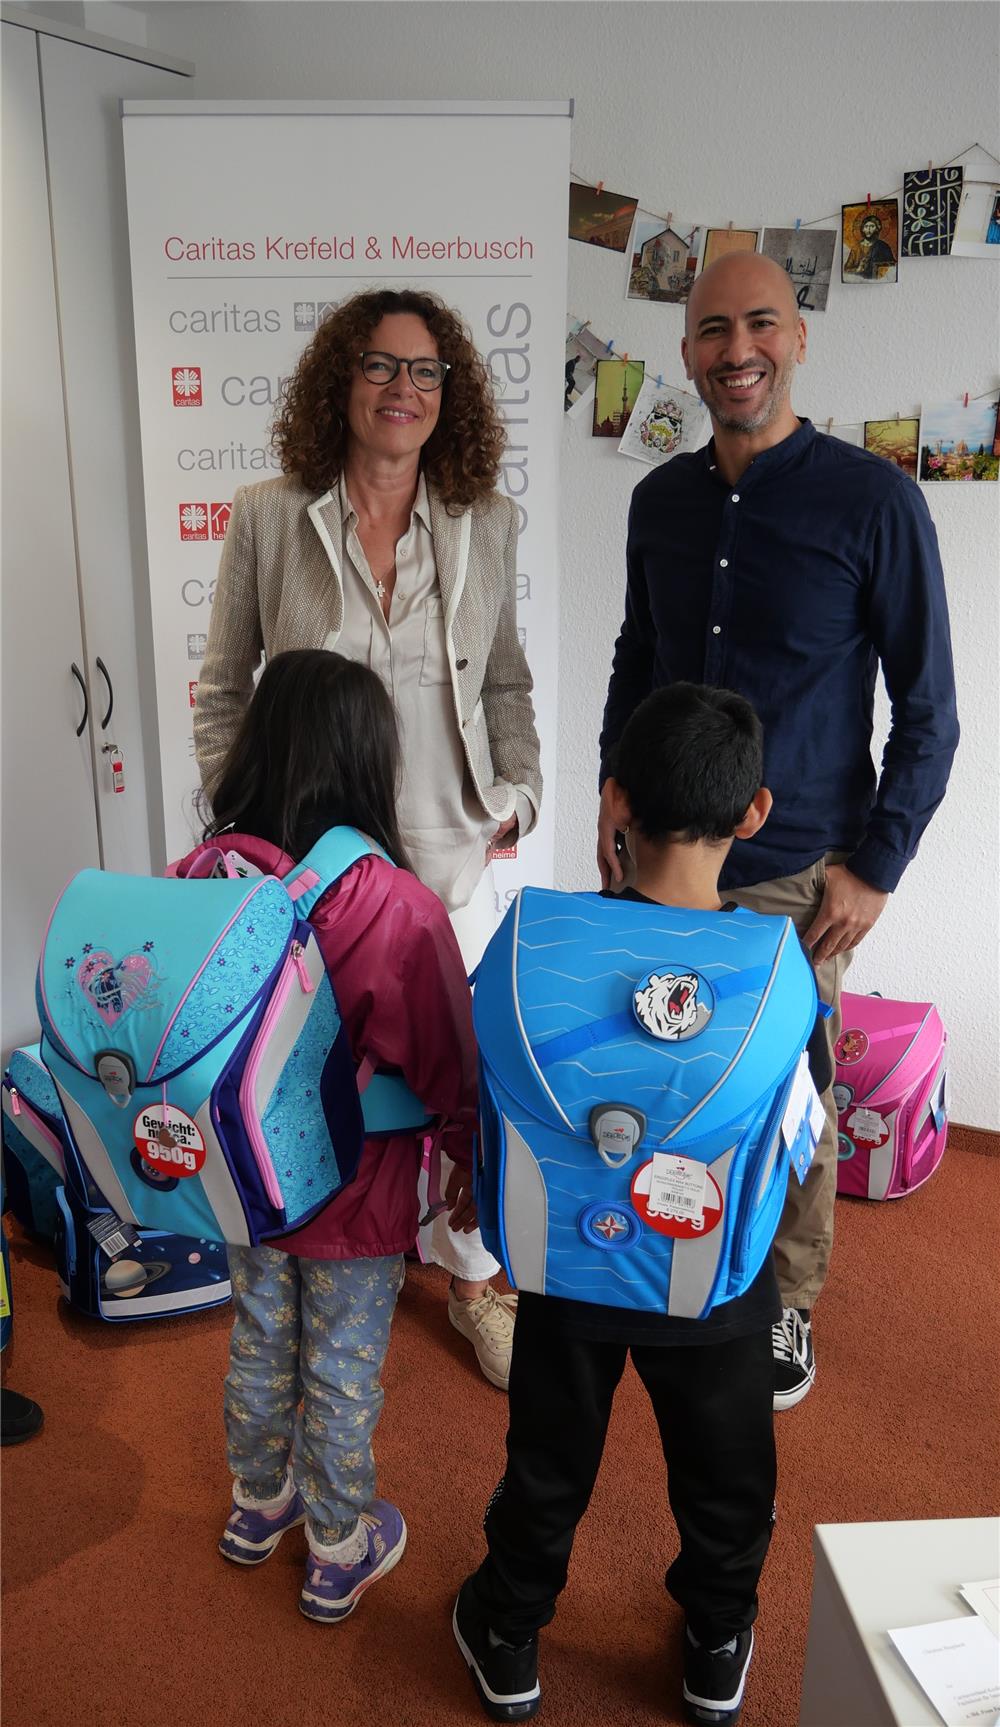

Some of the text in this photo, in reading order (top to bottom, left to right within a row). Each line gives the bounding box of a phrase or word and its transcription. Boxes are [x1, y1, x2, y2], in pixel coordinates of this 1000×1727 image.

[164, 235, 533, 261] Caritas Krefeld & Meerbusch
[168, 302, 281, 334] caritas
[175, 398, 201, 406] caritas
[177, 440, 284, 471] caritas
[182, 532, 207, 540] caritas
[146, 1140, 197, 1171] 950g
